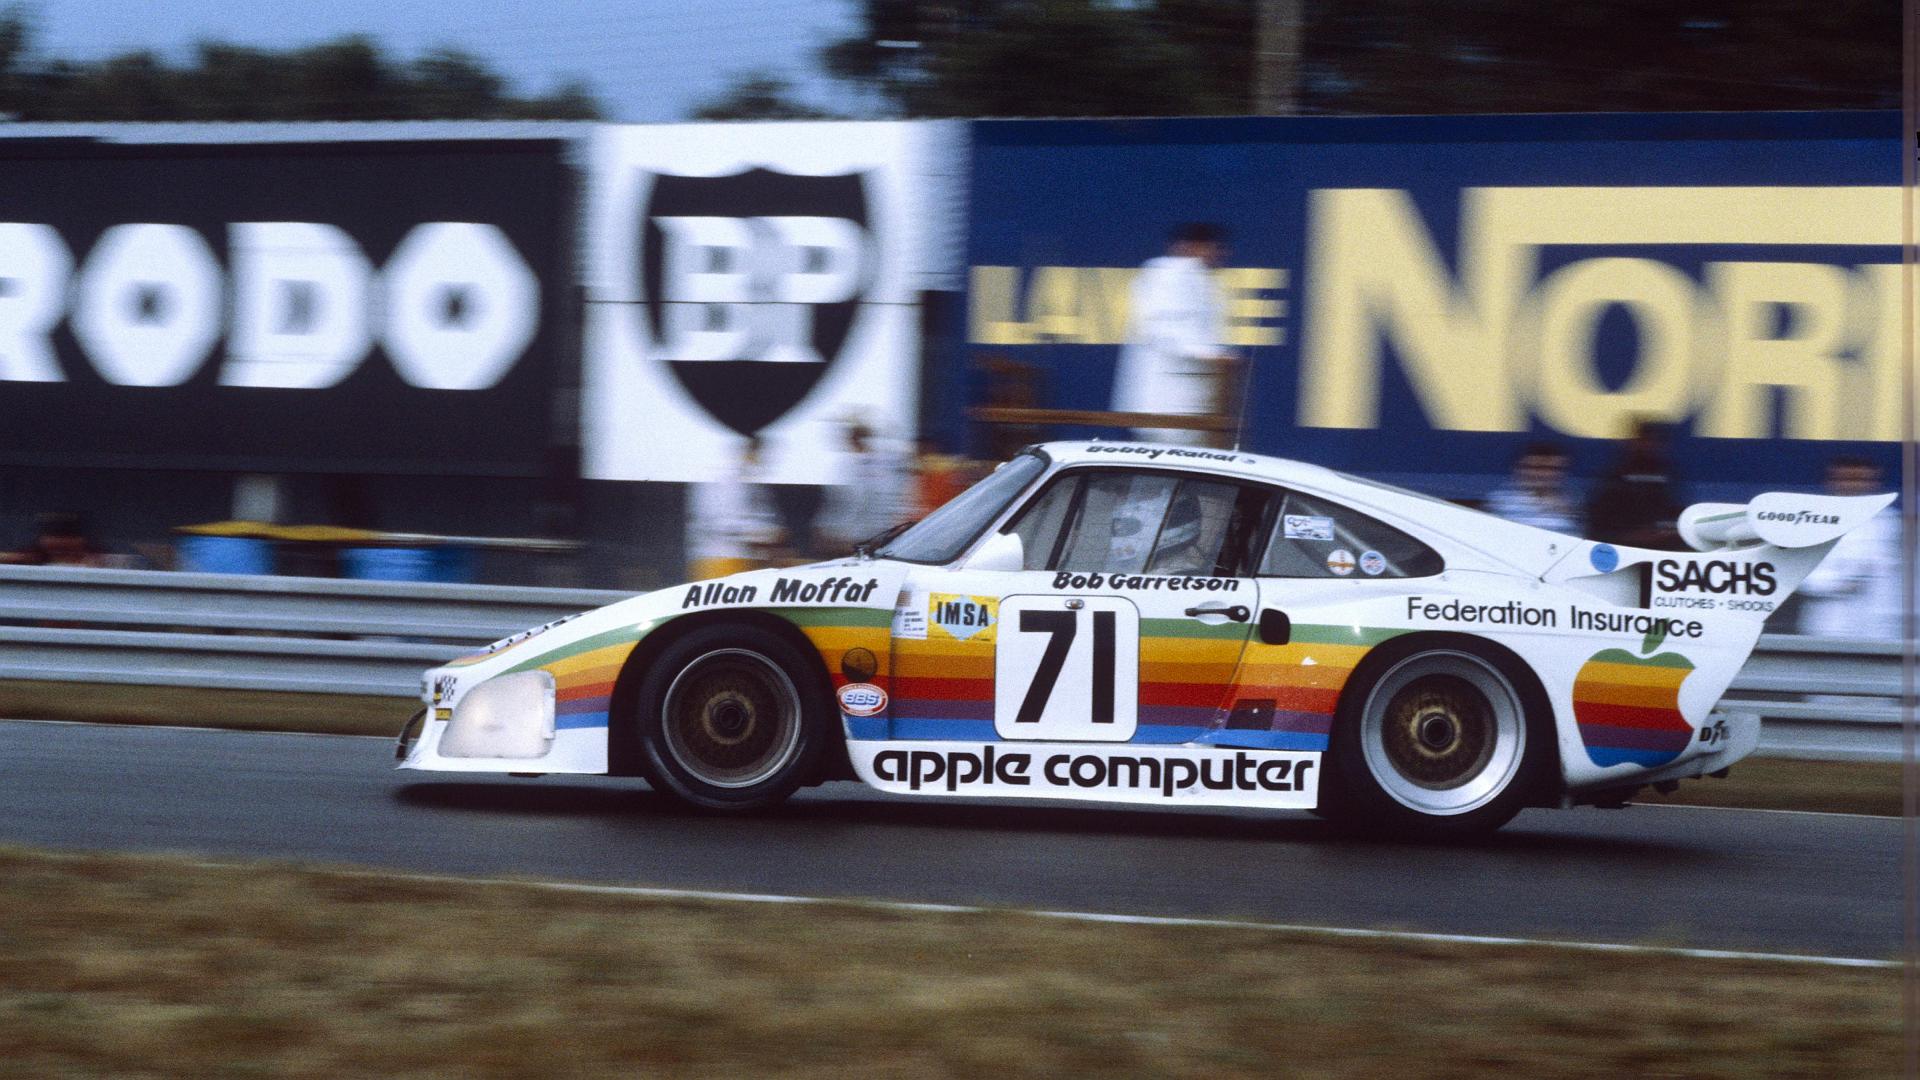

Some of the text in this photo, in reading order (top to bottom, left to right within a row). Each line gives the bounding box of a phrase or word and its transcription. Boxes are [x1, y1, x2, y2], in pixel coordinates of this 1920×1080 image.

[652, 216, 880, 362] BP
[1086, 446, 1238, 462] Bobby Rahal
[682, 577, 878, 609] Allan Moffat
[1053, 572, 1239, 591] Bob Garretson
[1656, 559, 1777, 596] SACHS
[936, 601, 989, 627] IMSA
[1407, 597, 1703, 638] Federation Insurance
[1654, 596, 1775, 612] CLUTCHES SHOCKS
[1015, 609, 1116, 724] 71
[845, 692, 880, 706] BBS
[873, 746, 1313, 797] apple computer
